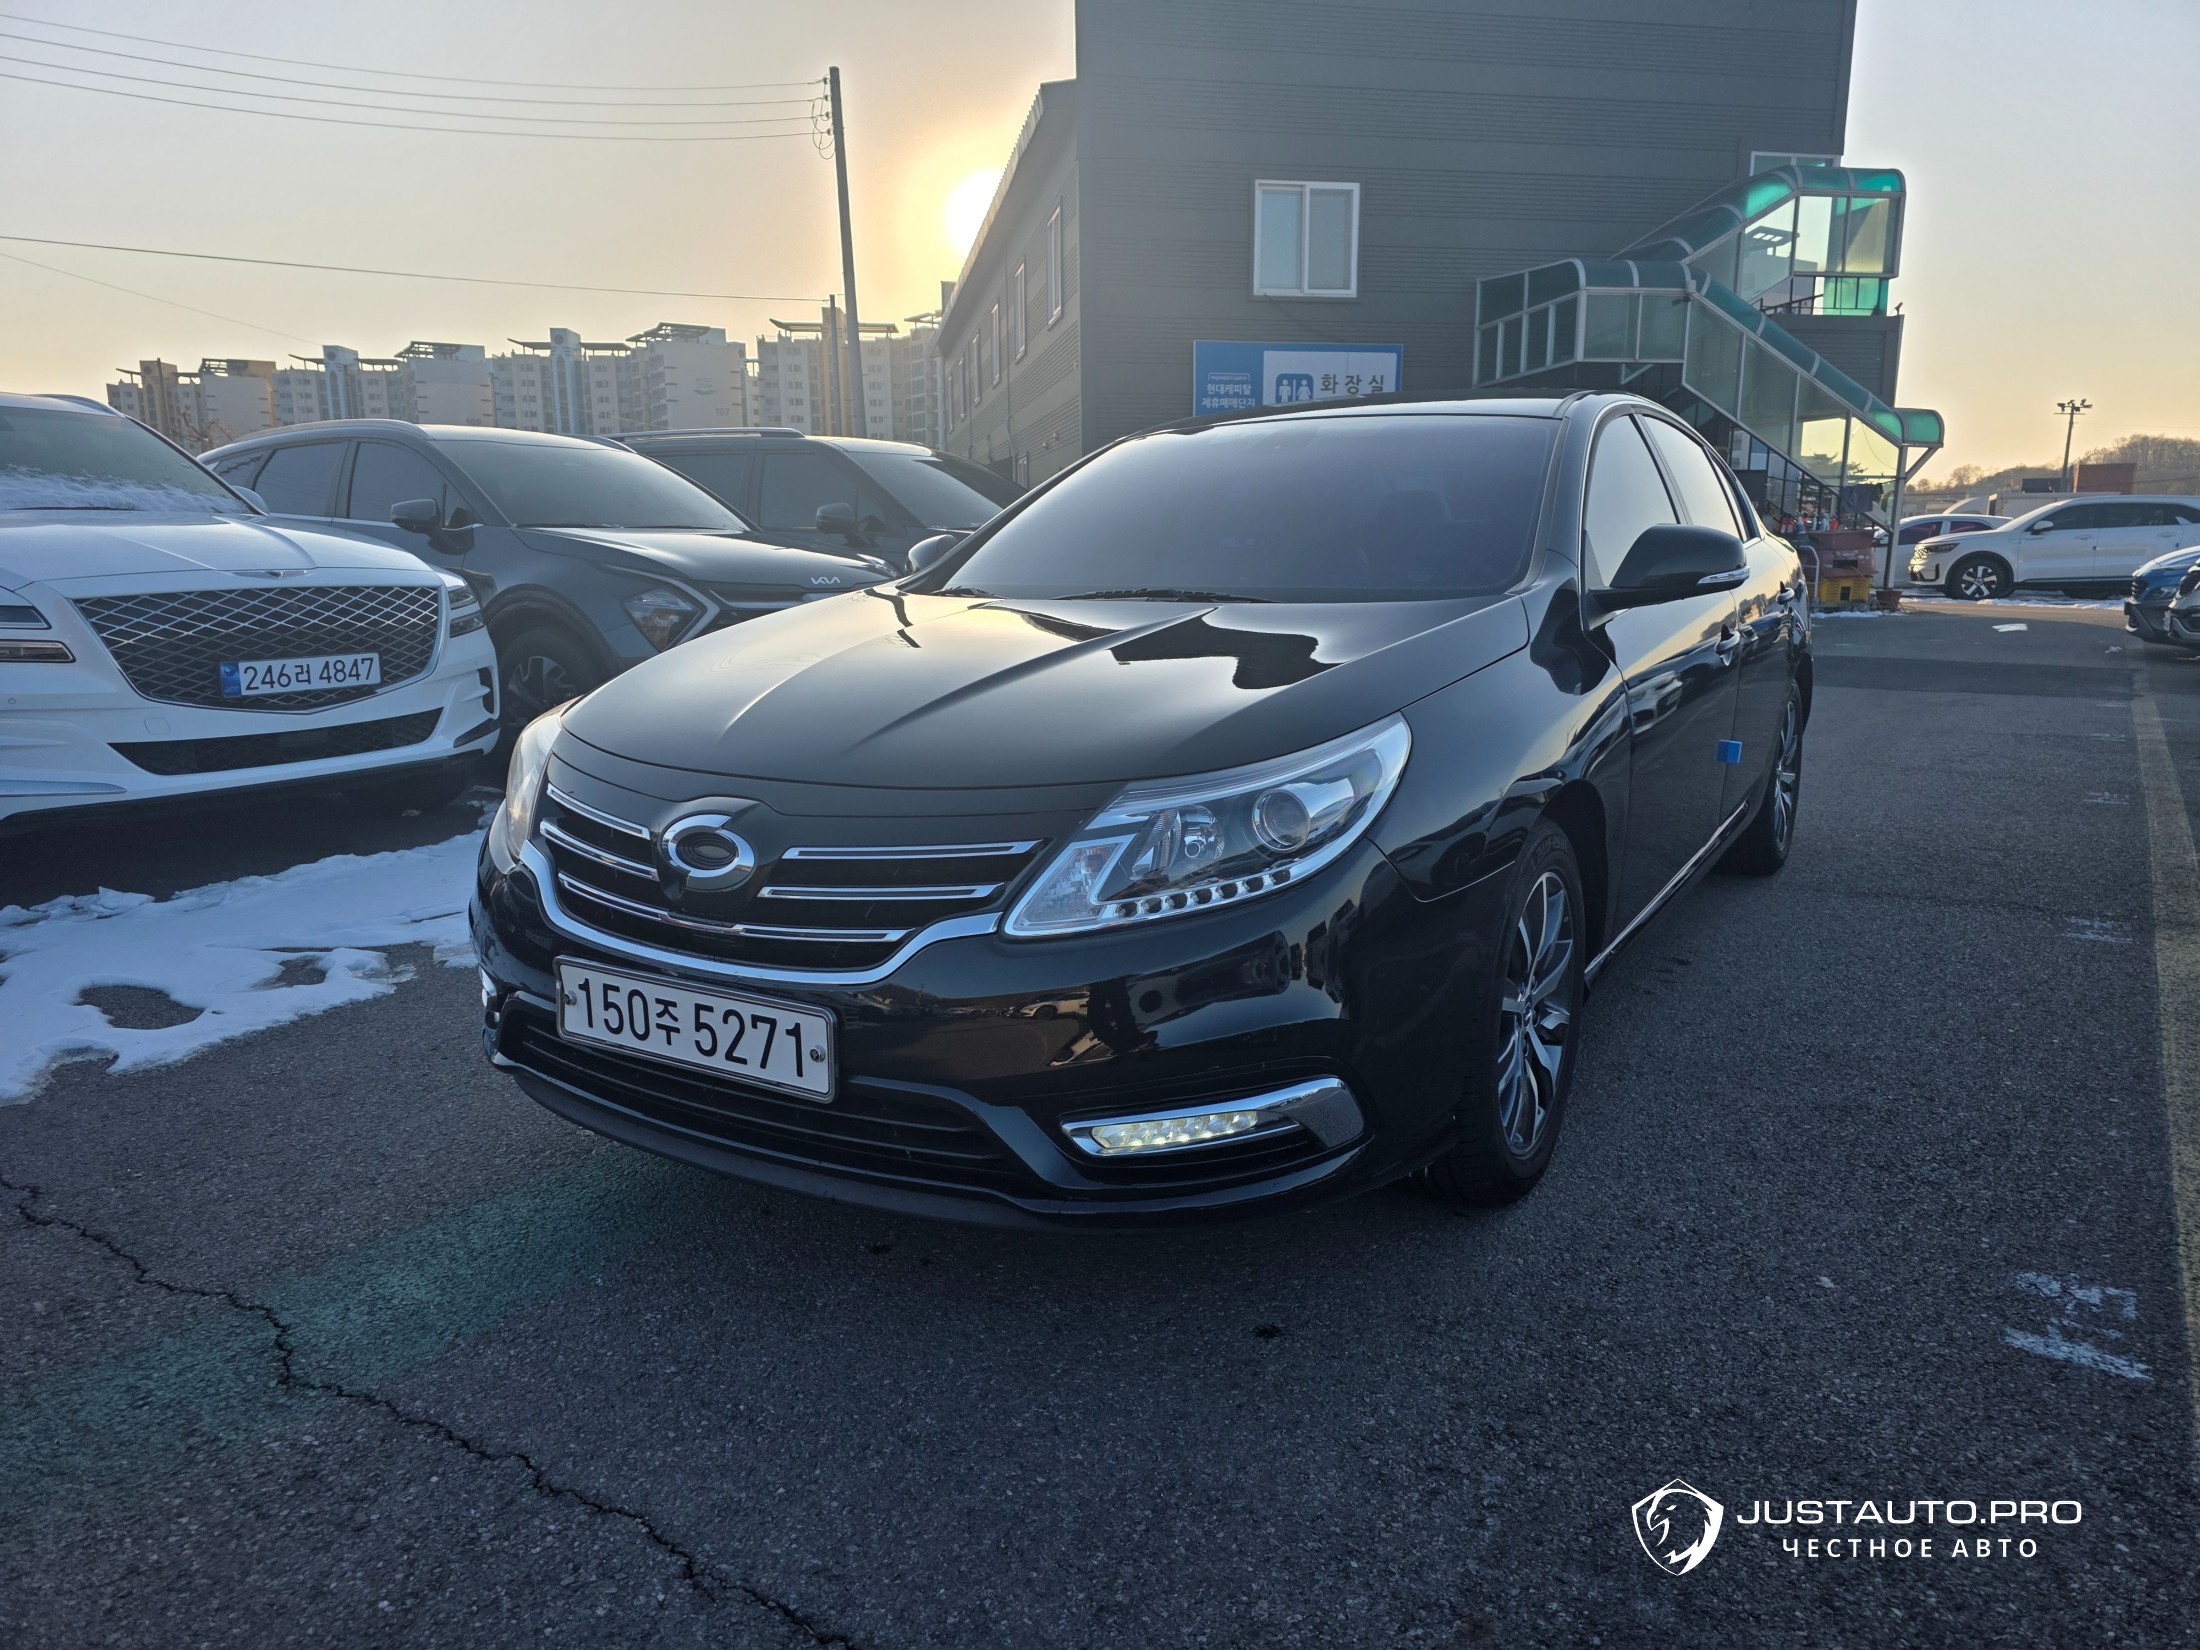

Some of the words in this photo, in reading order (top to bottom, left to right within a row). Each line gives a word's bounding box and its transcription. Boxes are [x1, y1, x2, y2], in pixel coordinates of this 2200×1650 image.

[715, 407, 730, 416] 107
[319, 657, 374, 684] 4847
[578, 977, 681, 1046] 150주
[694, 1002, 804, 1078] 5271
